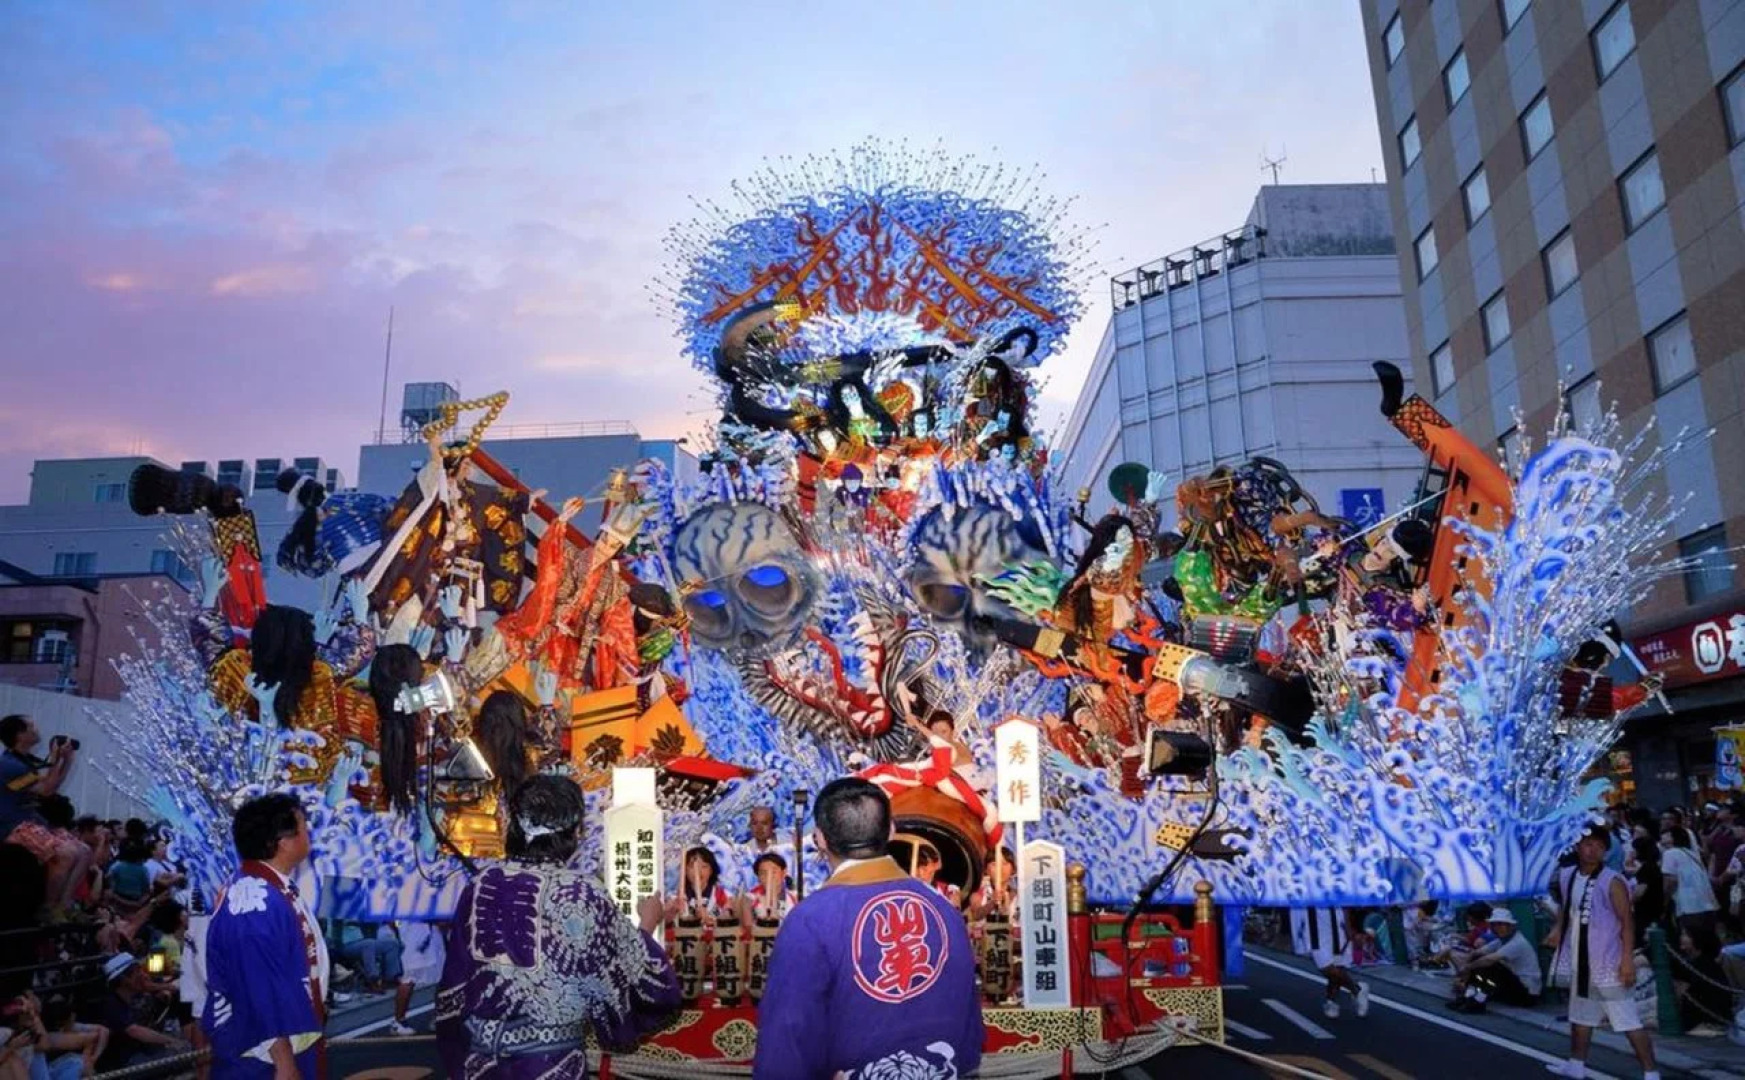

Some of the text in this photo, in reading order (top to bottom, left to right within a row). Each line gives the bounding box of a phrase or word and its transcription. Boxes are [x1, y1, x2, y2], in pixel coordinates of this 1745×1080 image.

[1007, 739, 1031, 806] 秀作
[1032, 855, 1057, 991] 下組町山車組
[715, 935, 741, 995] 下組町
[986, 929, 1011, 989] 下組町
